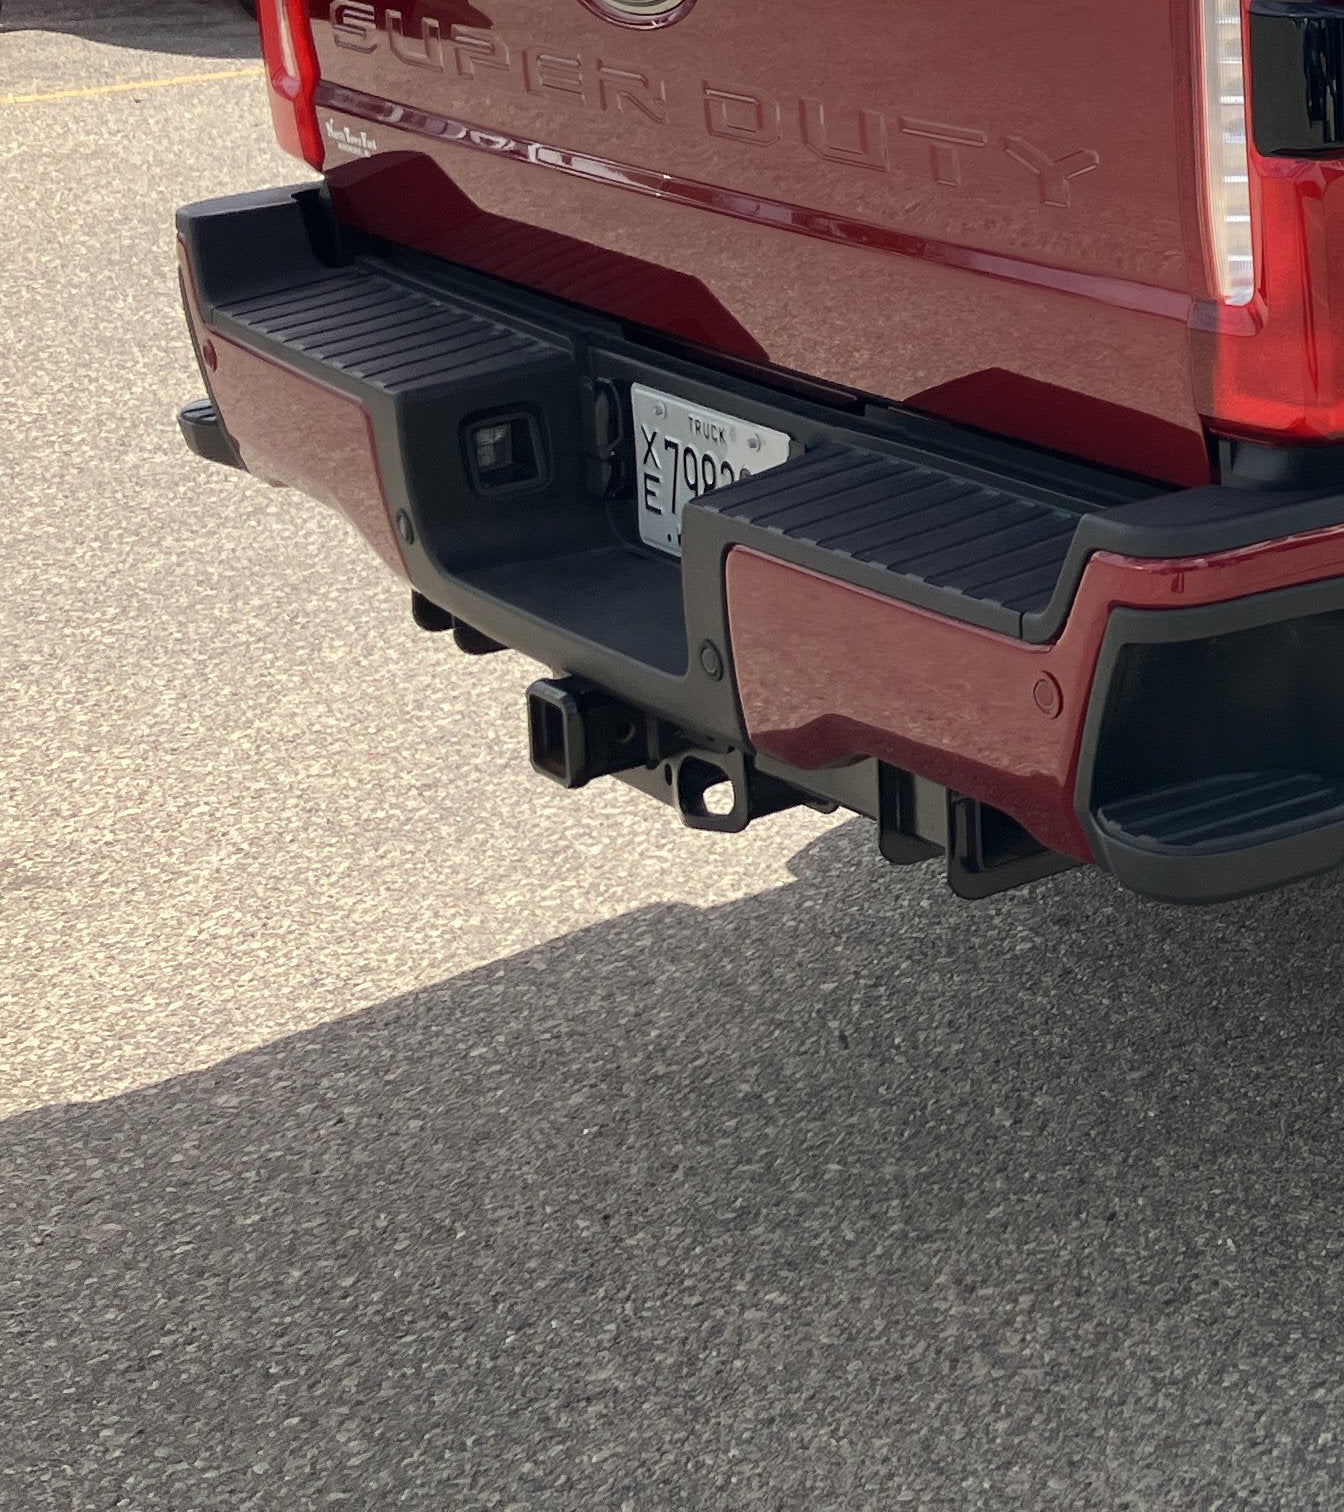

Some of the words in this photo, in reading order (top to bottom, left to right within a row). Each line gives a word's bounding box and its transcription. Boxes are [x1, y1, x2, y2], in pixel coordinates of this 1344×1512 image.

[330, 0, 667, 125] SUPER
[702, 80, 1100, 209] DUTY
[687, 415, 727, 445] TRUCK
